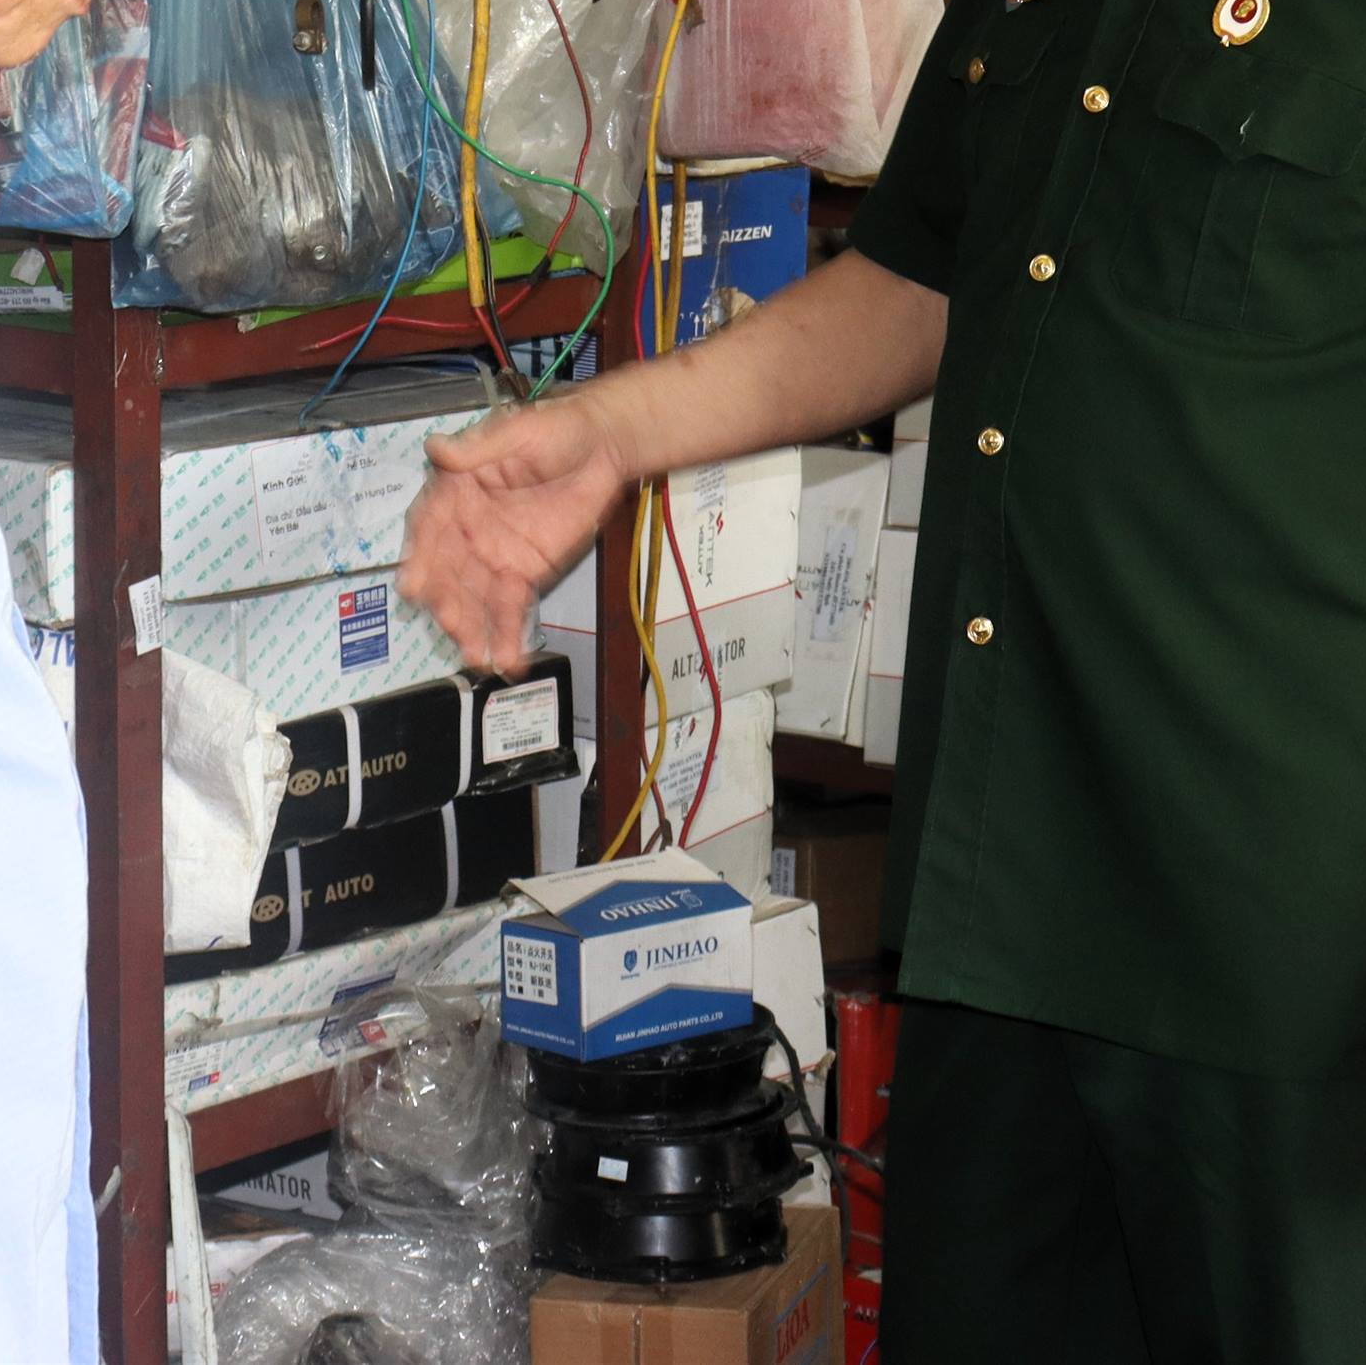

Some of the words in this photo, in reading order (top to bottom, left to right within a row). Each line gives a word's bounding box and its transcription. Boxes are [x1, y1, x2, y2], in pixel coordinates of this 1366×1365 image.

[672, 637, 746, 683] ALTEATOR
[361, 750, 408, 781] AUTO
[324, 873, 375, 903] AUTO
[599, 896, 681, 922] JINHAO
[645, 935, 719, 970] JINHAO
[242, 1173, 312, 1202] NATOR
